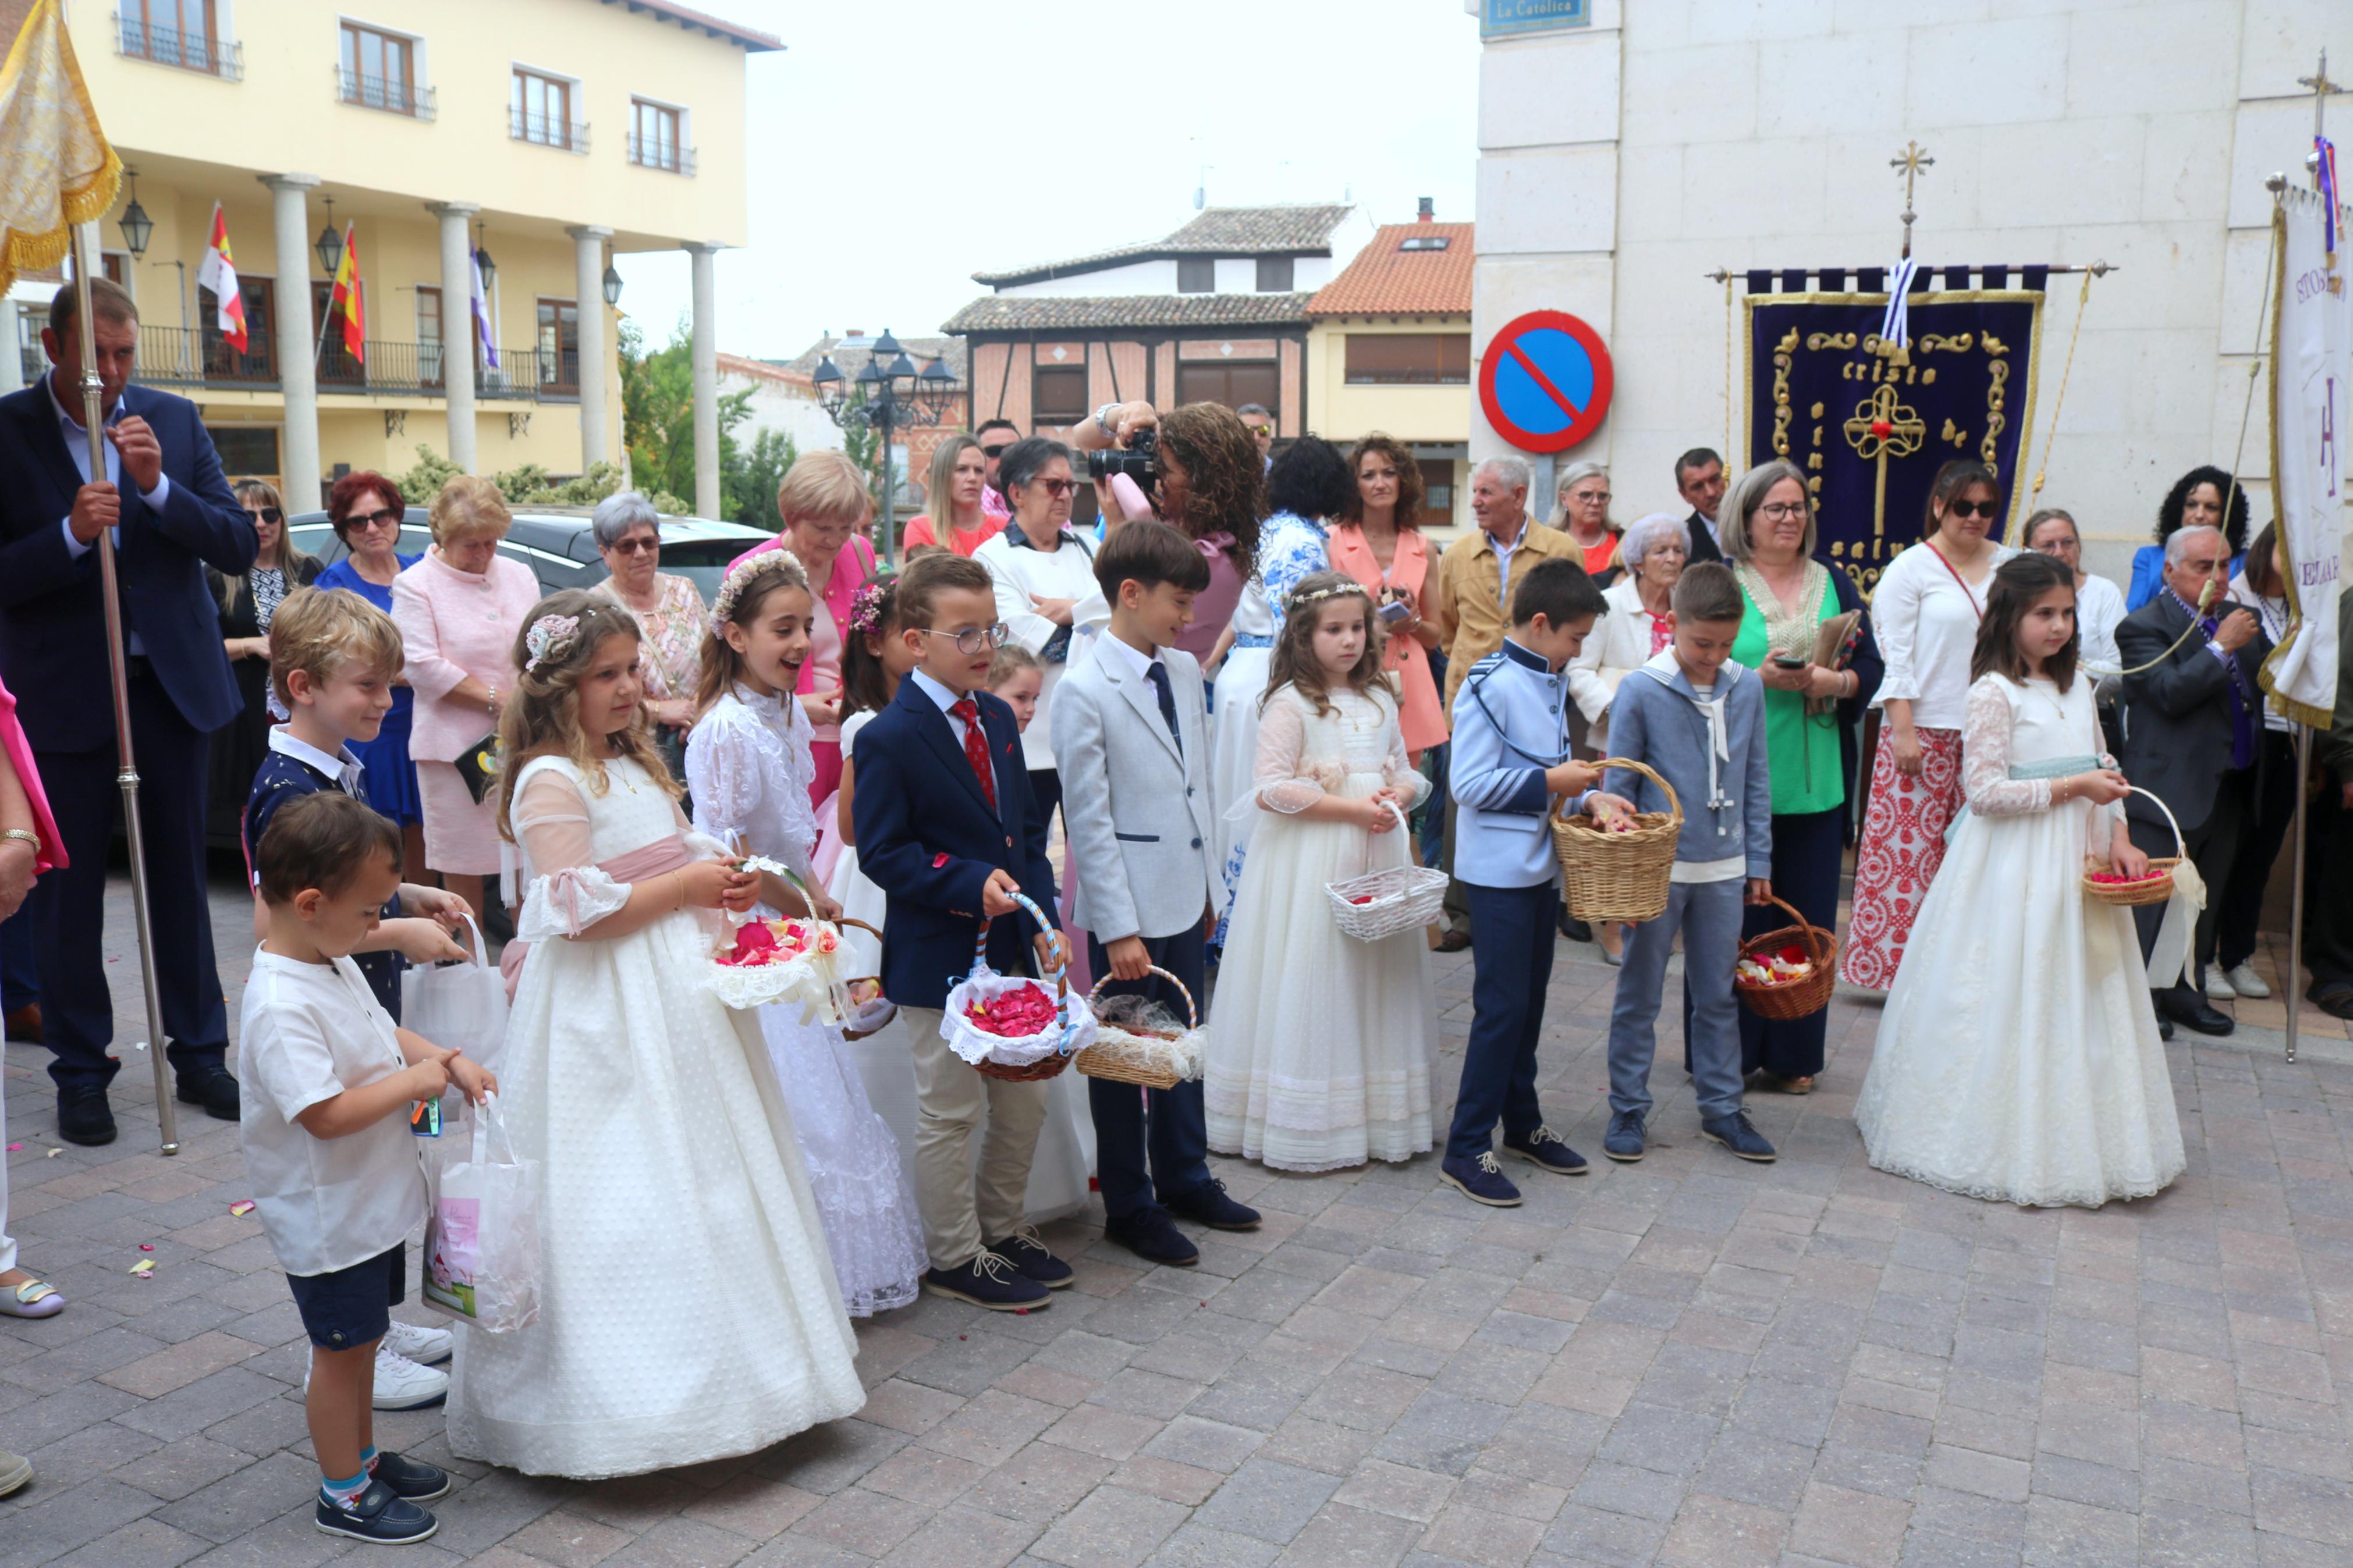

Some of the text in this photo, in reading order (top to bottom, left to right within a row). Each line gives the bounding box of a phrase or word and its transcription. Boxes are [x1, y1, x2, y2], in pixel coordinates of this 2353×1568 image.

[1497, 2, 1512, 19] La
[1843, 359, 1936, 385] cristo
[1941, 418, 1967, 448] de
